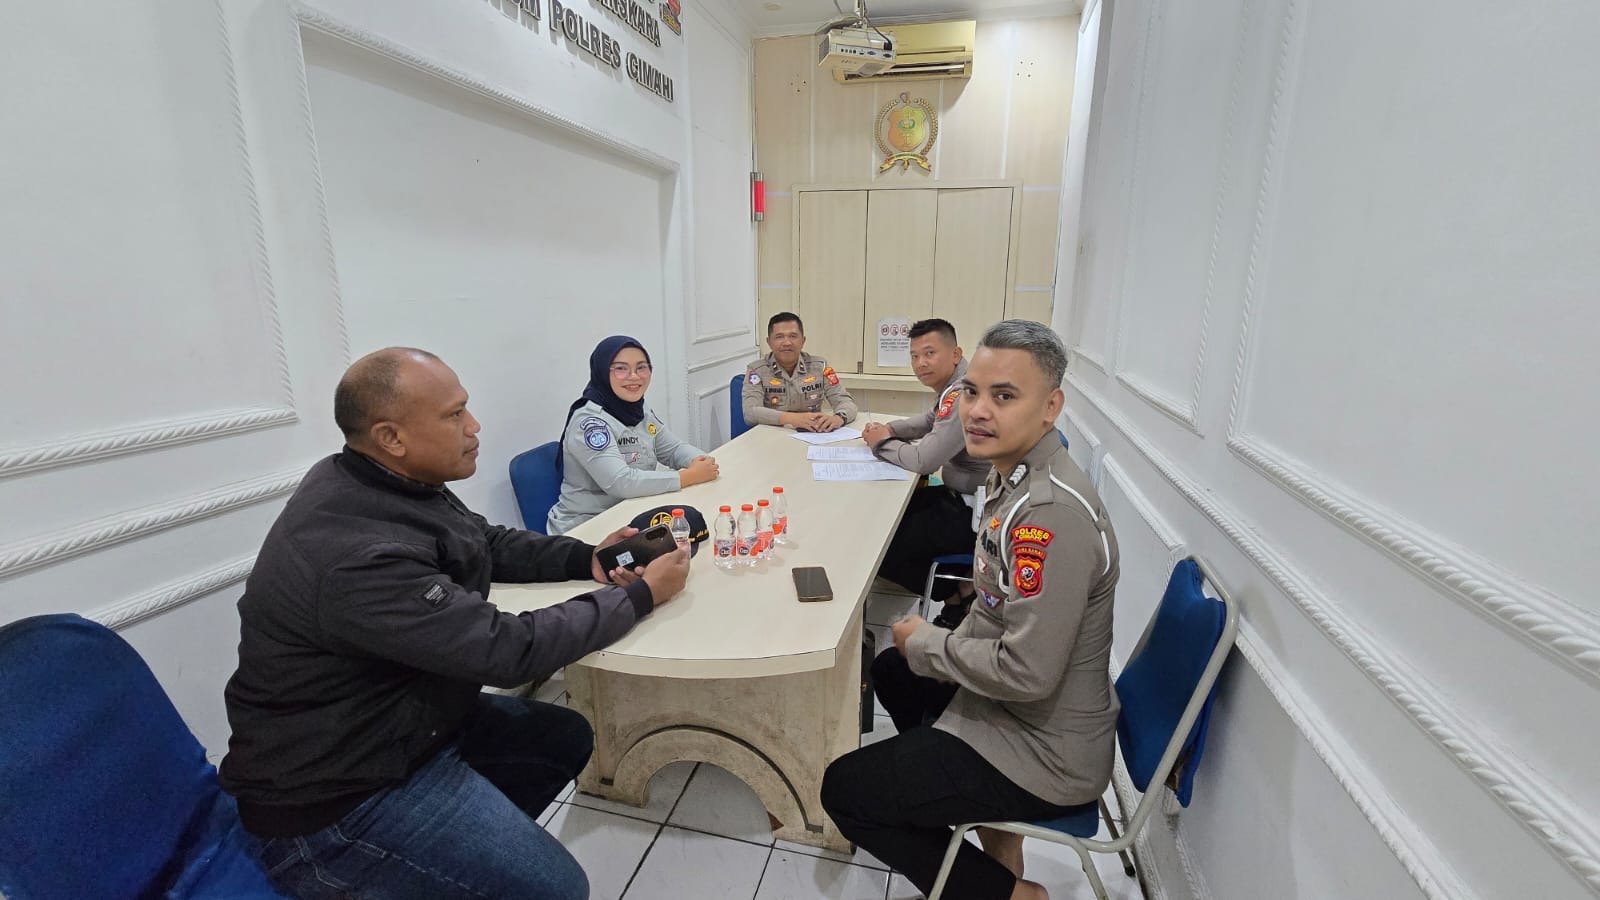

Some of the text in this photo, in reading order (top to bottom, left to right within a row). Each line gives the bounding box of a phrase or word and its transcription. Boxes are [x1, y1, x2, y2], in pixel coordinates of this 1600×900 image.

[548, 0, 673, 103] POLRES CIMAHI
[1014, 527, 1050, 540] POLRES
